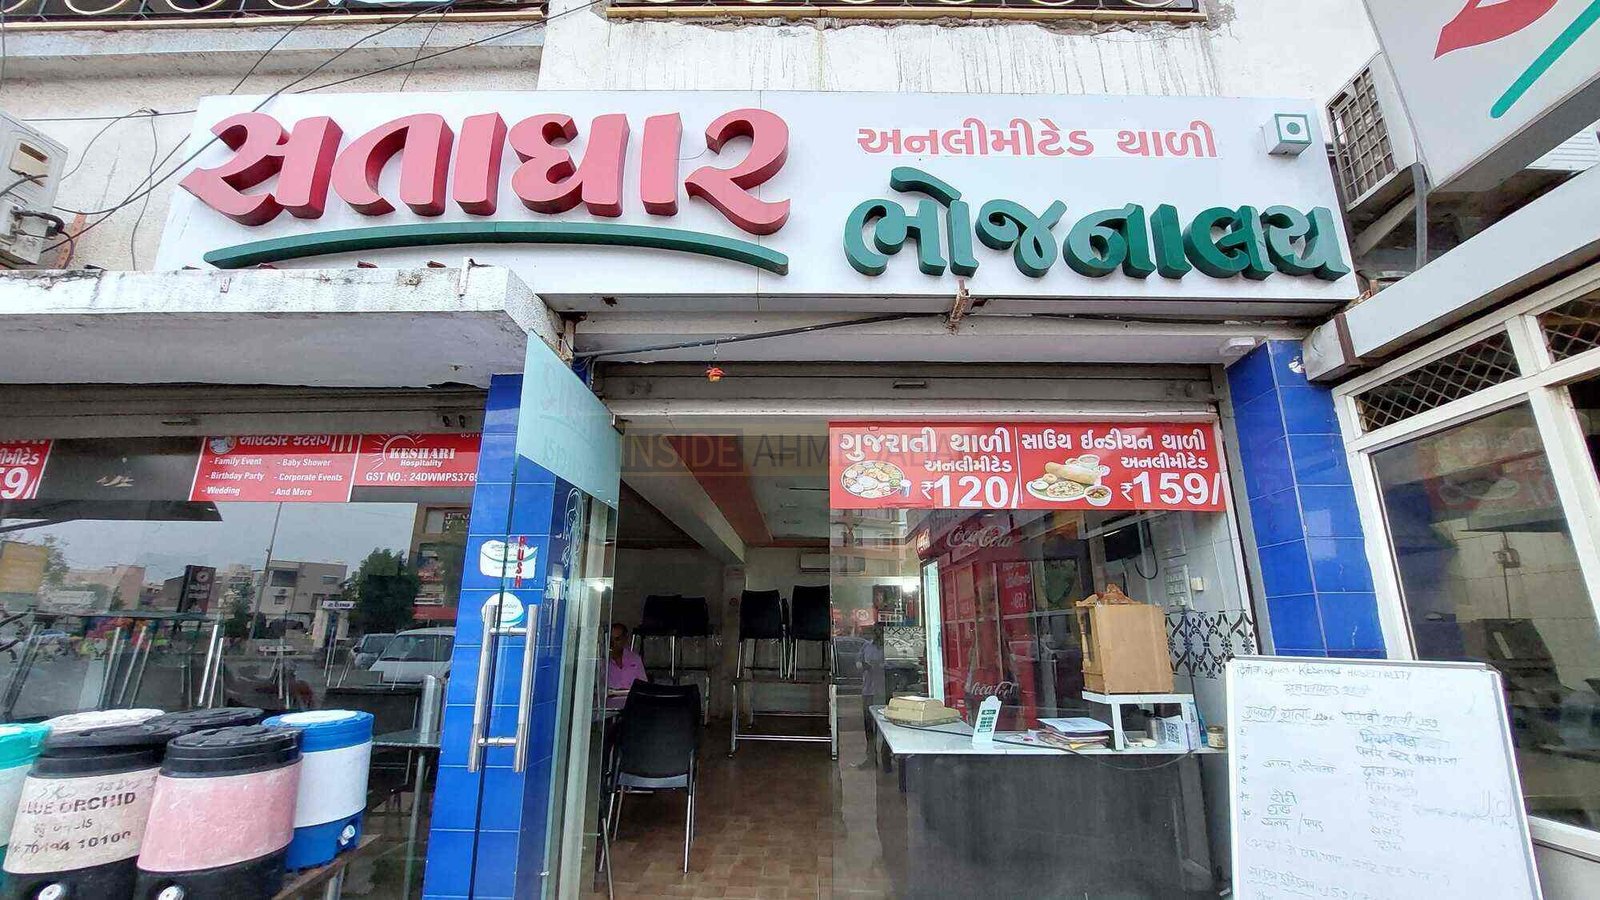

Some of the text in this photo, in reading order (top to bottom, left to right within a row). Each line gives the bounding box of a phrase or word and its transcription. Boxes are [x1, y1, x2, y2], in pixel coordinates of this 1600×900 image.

[857, 118, 1218, 158] અનલીમીટેડ થાળી
[843, 166, 1350, 281] ભોજનાલય
[840, 427, 1011, 461] ગુજરાતી થાળી
[1021, 428, 1206, 451] સાઉથ ઈન્ડીયન થાળી
[389, 447, 456, 460] KESHARI
[214, 457, 262, 466] Family Event
[283, 458, 331, 467] Baby Shower
[400, 459, 443, 468] Hospitality
[924, 456, 1012, 473] અનલીમીટેડ
[1120, 452, 1209, 470] અનલીમીટેડ
[211, 471, 265, 481] Birthday Party
[279, 473, 316, 482] Corporate
[366, 472, 385, 482] GST
[207, 486, 241, 496] Wedding
[275, 488, 312, 496] And More
[22, 792, 136, 815] LUE ORCHID
